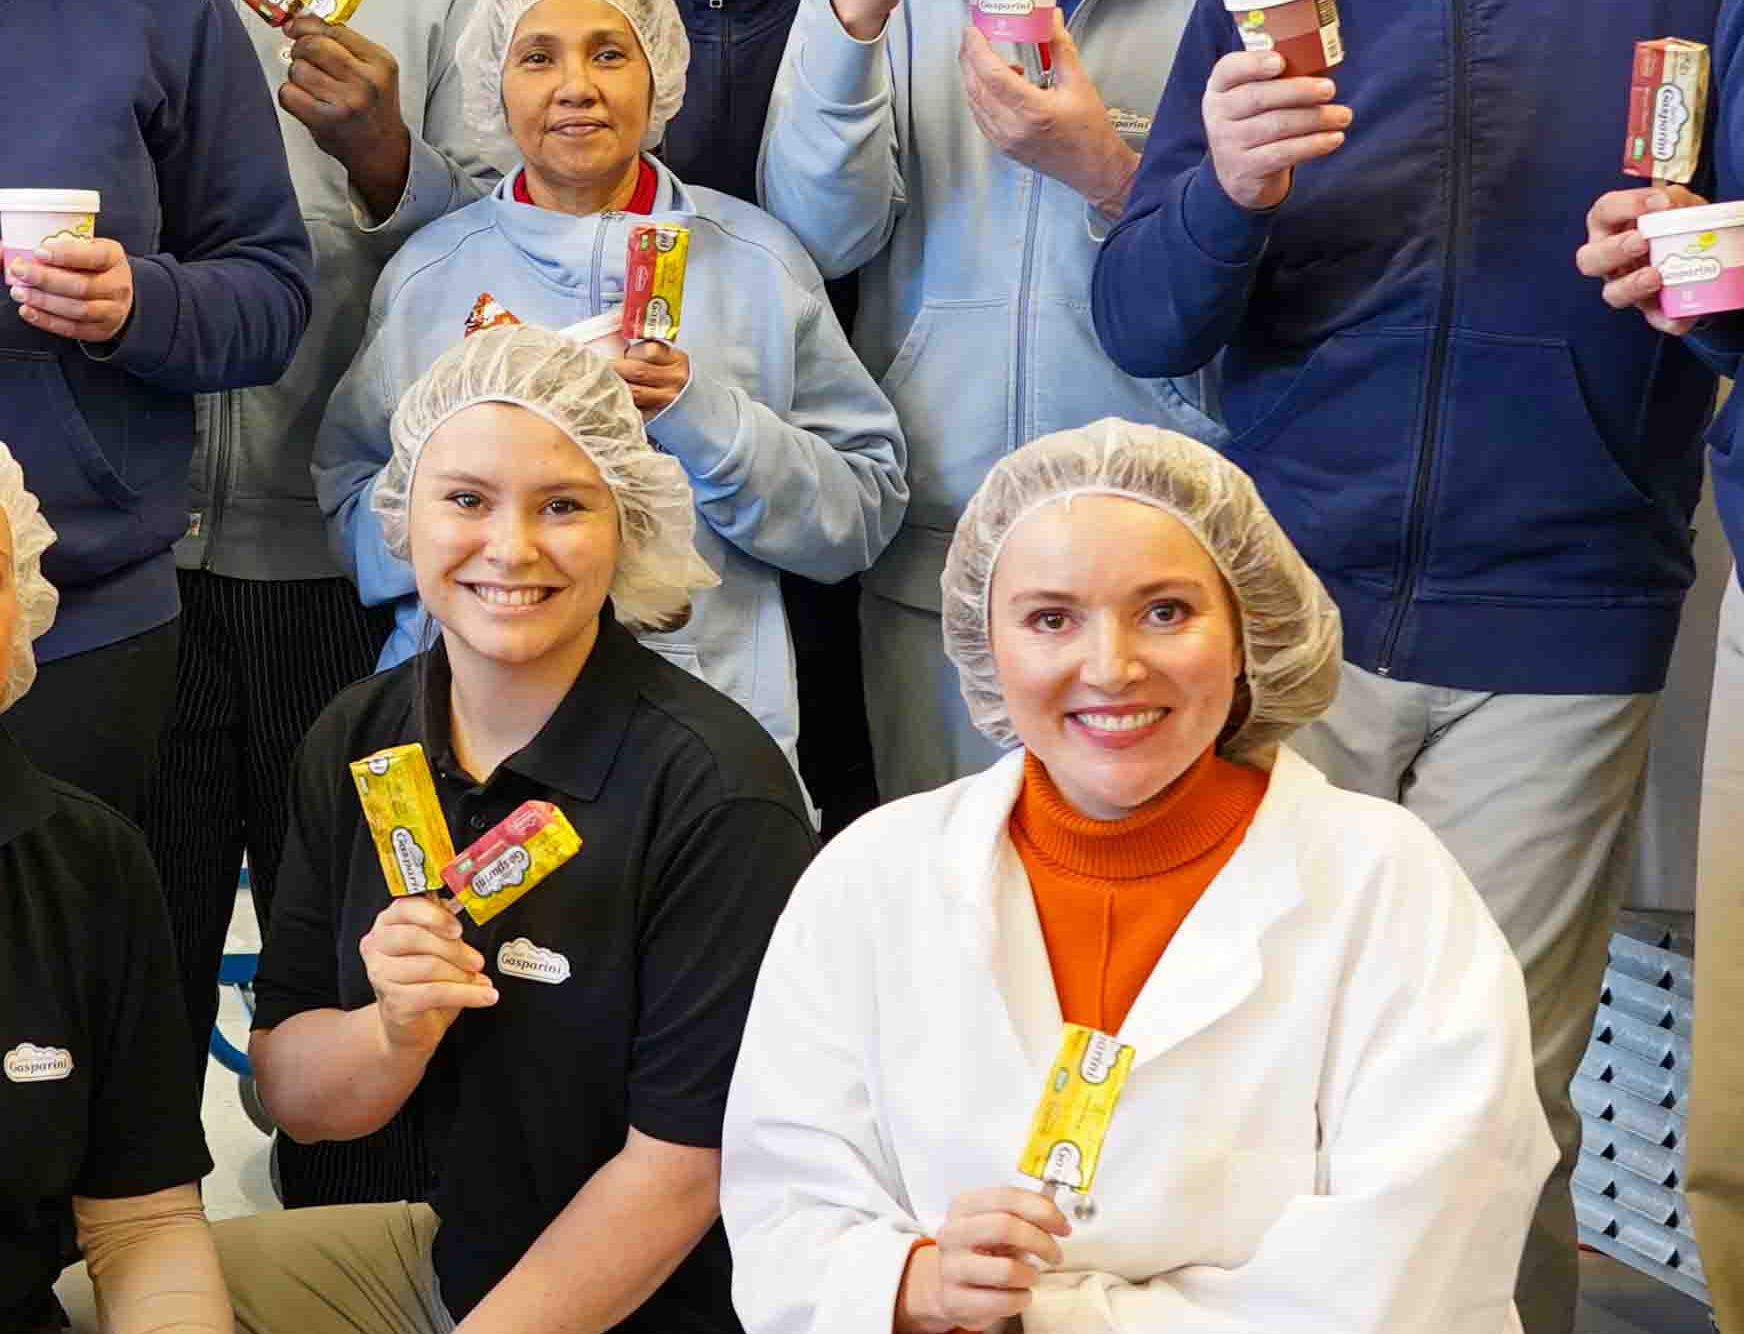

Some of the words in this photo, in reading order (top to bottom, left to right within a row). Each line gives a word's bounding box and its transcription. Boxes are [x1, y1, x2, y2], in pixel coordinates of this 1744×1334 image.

[476, 850, 525, 892] Gasparini
[502, 952, 560, 974] Gasparini
[9, 1059, 64, 1074] Gasparini
